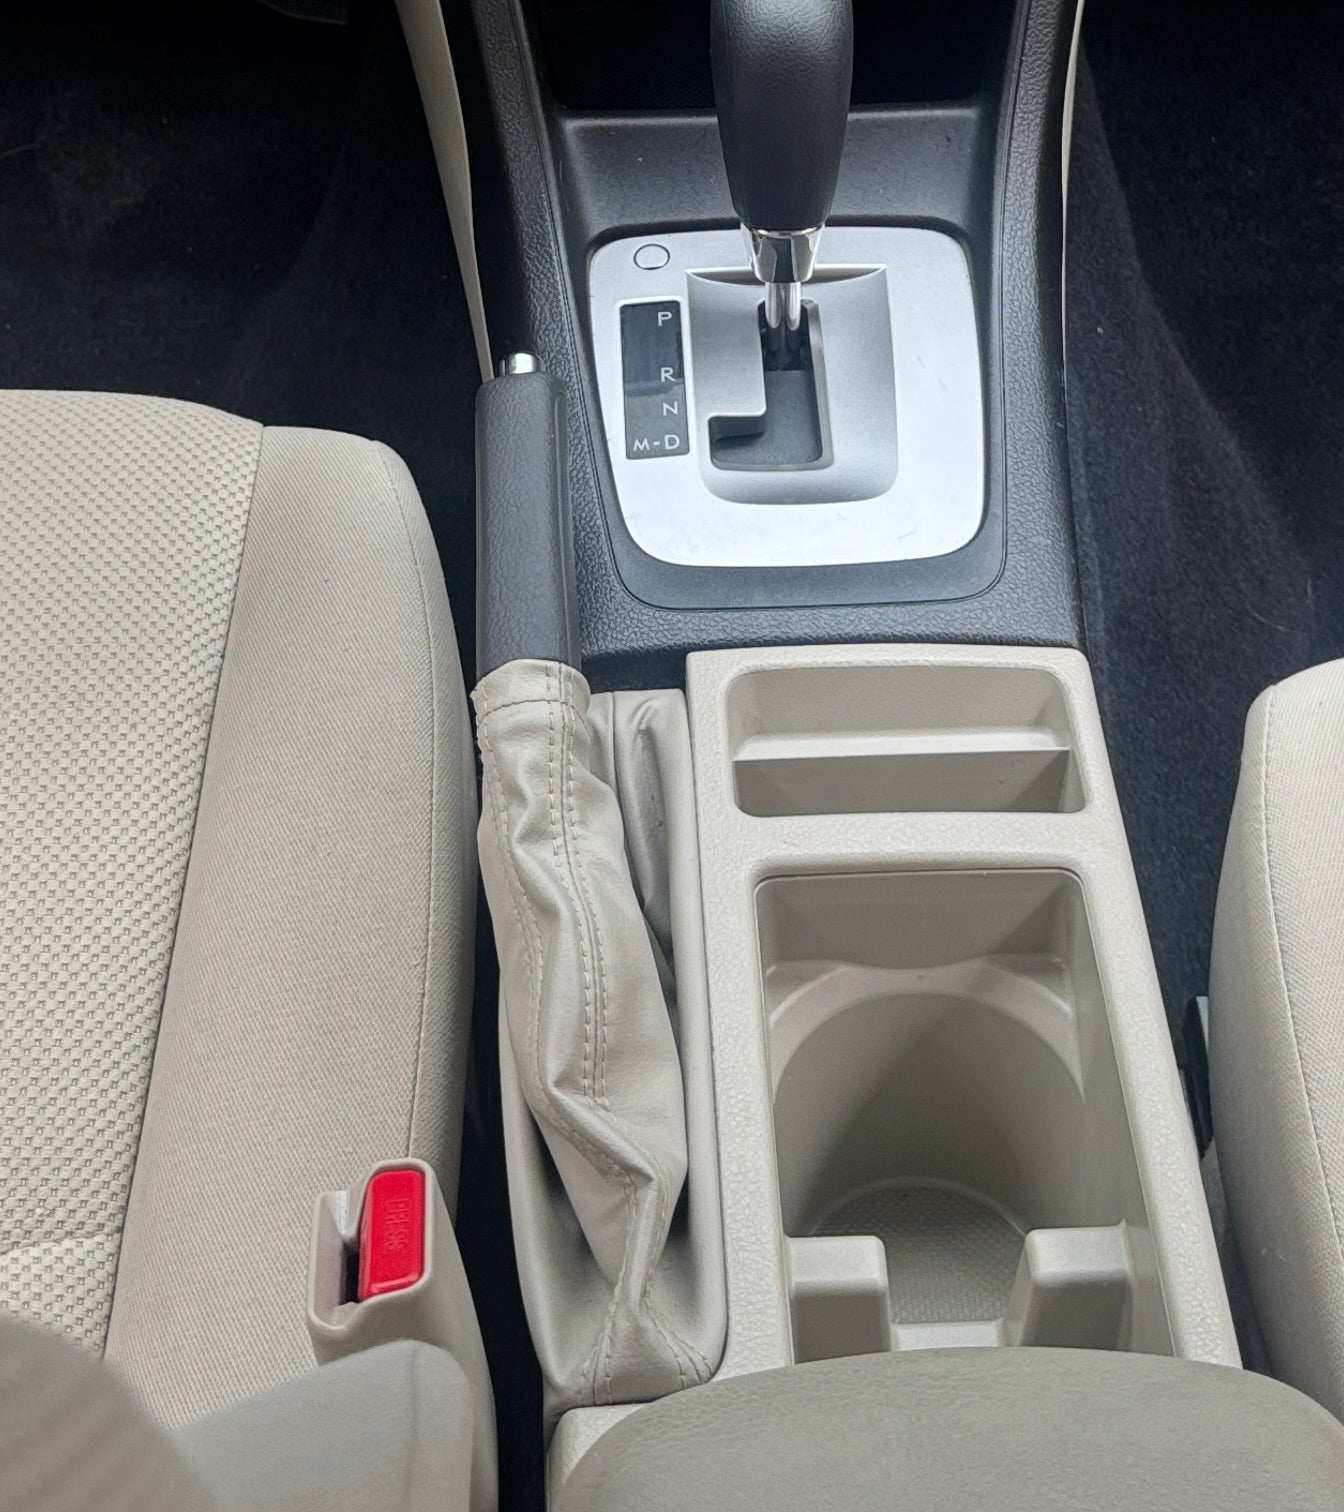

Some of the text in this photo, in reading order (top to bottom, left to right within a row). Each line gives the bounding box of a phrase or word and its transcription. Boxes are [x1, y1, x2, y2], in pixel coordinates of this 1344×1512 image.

[657, 311, 672, 327] P
[660, 367, 676, 382] R
[662, 400, 678, 417] N
